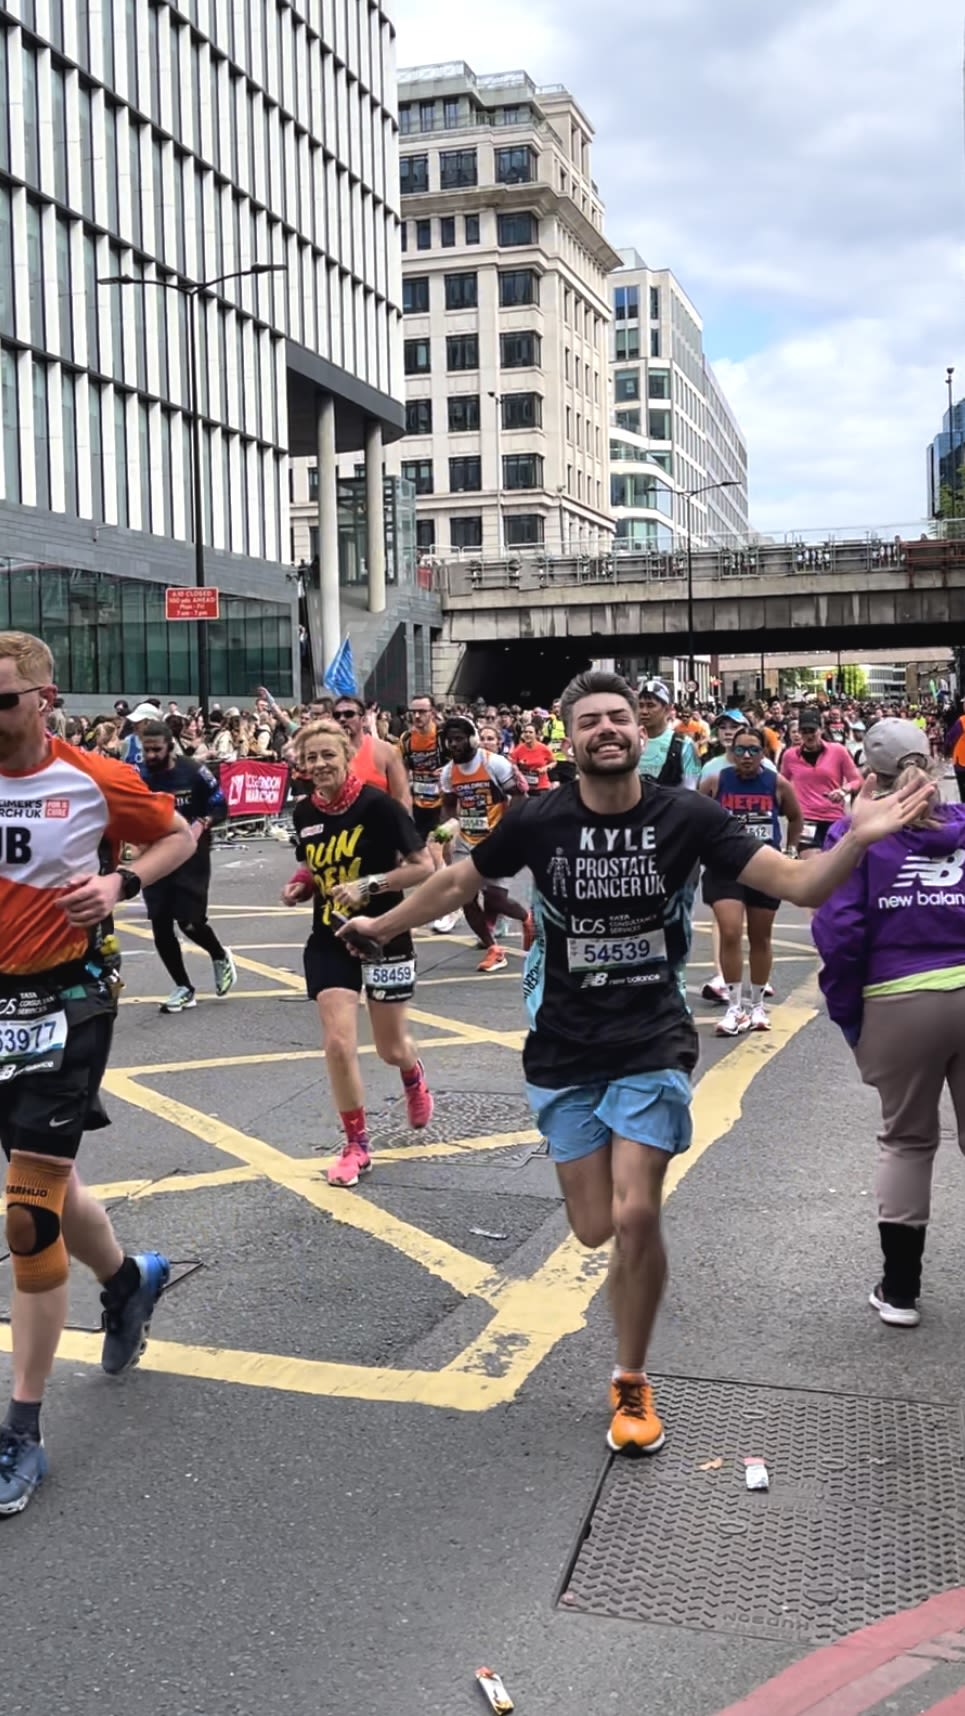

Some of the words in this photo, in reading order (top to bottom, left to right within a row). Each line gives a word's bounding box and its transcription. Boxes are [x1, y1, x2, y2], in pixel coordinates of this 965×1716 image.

[25, 809, 41, 819] UK
[306, 824, 365, 872] RUN
[580, 826, 657, 851] KYLE
[575, 854, 657, 878] PROSTATE
[575, 876, 641, 900] CANCER
[644, 874, 666, 896] UK
[878, 894, 913, 909] new
[608, 913, 631, 921] TATA
[584, 938, 650, 964] 54539
[373, 966, 411, 983] 58459
[626, 973, 661, 984] balance
